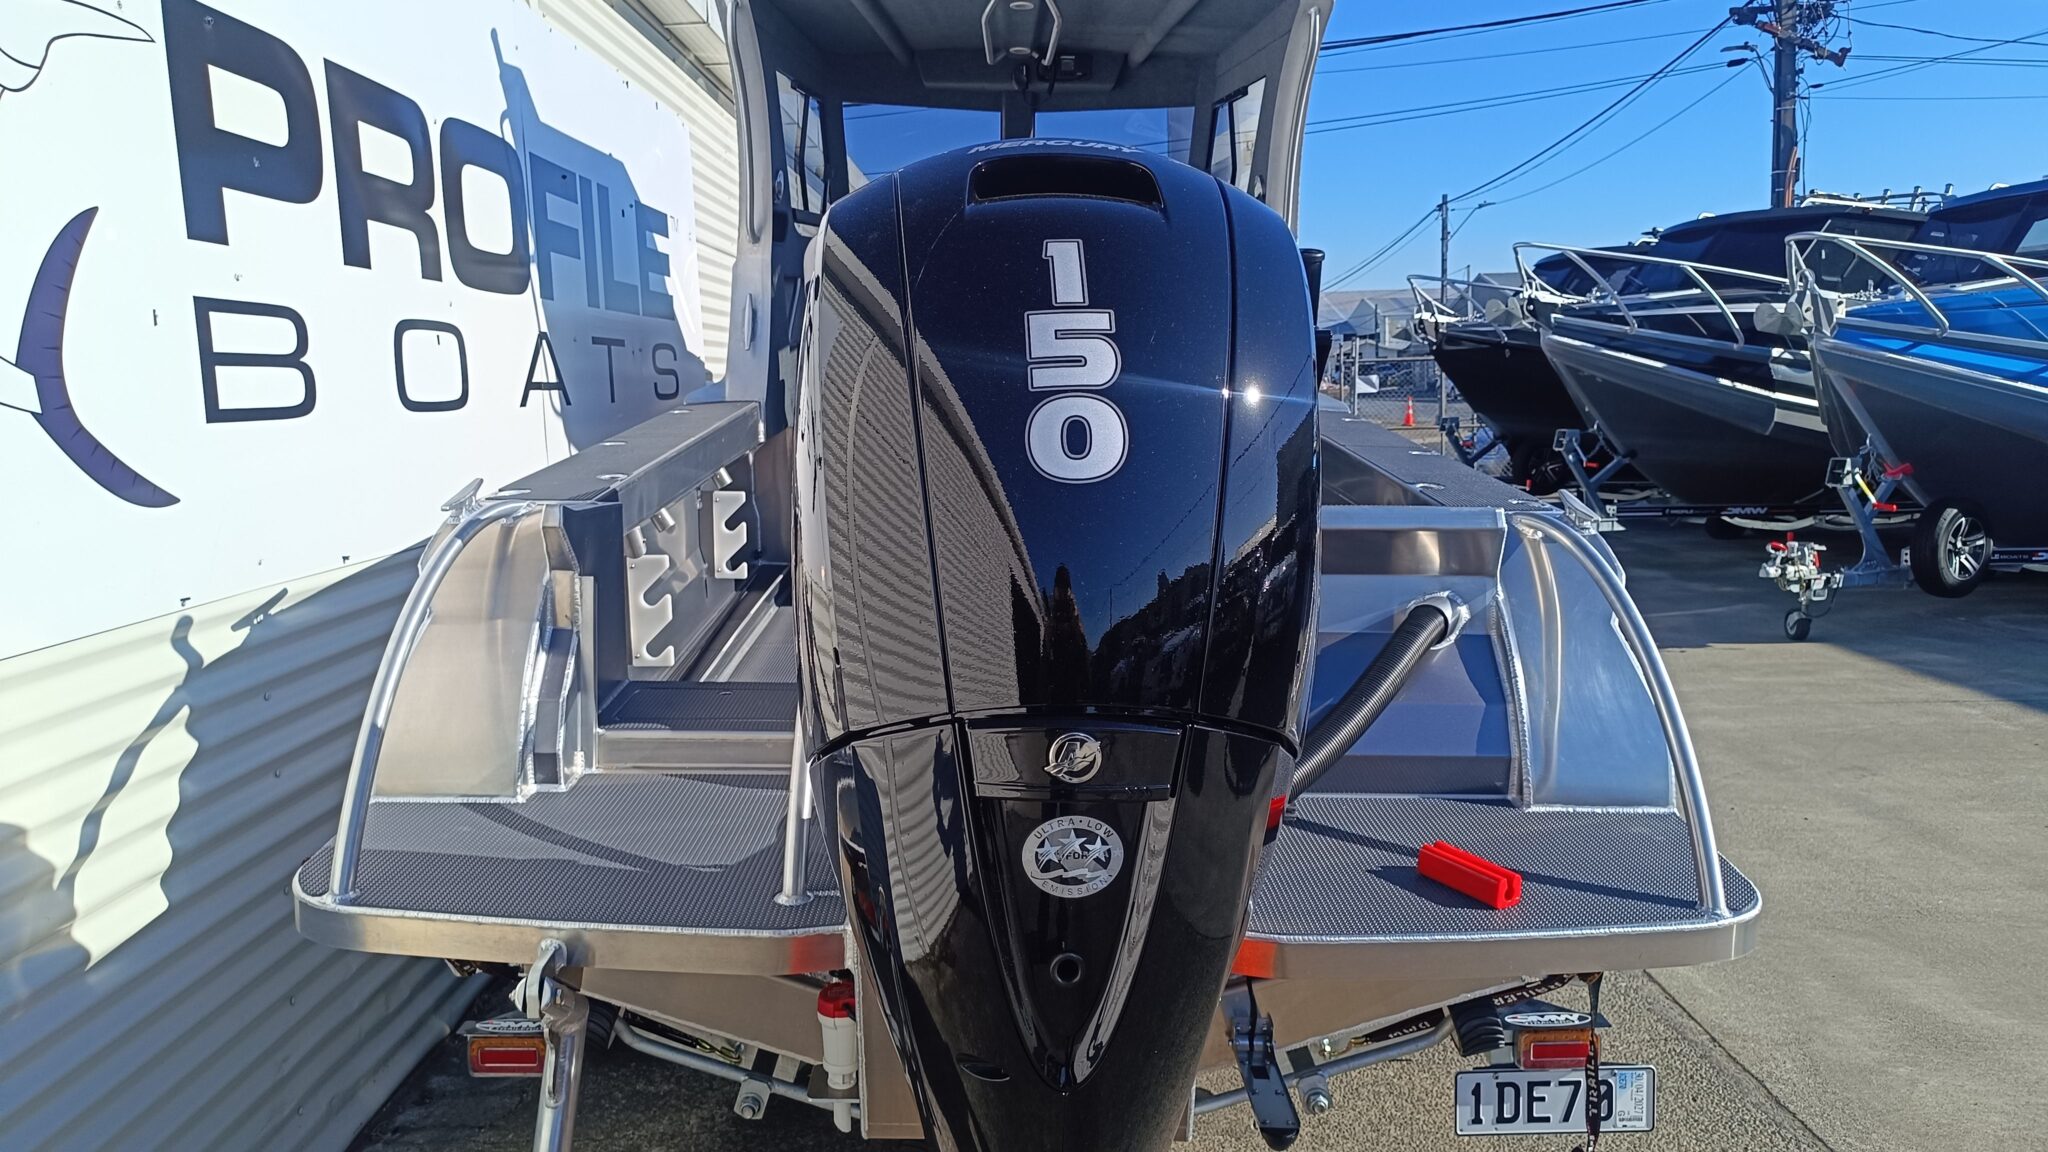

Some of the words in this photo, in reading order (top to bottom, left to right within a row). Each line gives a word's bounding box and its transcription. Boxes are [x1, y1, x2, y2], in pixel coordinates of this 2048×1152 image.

[160, 0, 675, 320] PROFILE
[967, 139, 1145, 154] MERCURY
[193, 296, 680, 424] BOATS
[1024, 239, 1129, 484] 150
[1034, 818, 1075, 839] ULTRA
[1087, 819, 1113, 838] LOW
[1041, 877, 1108, 896] EMISSION
